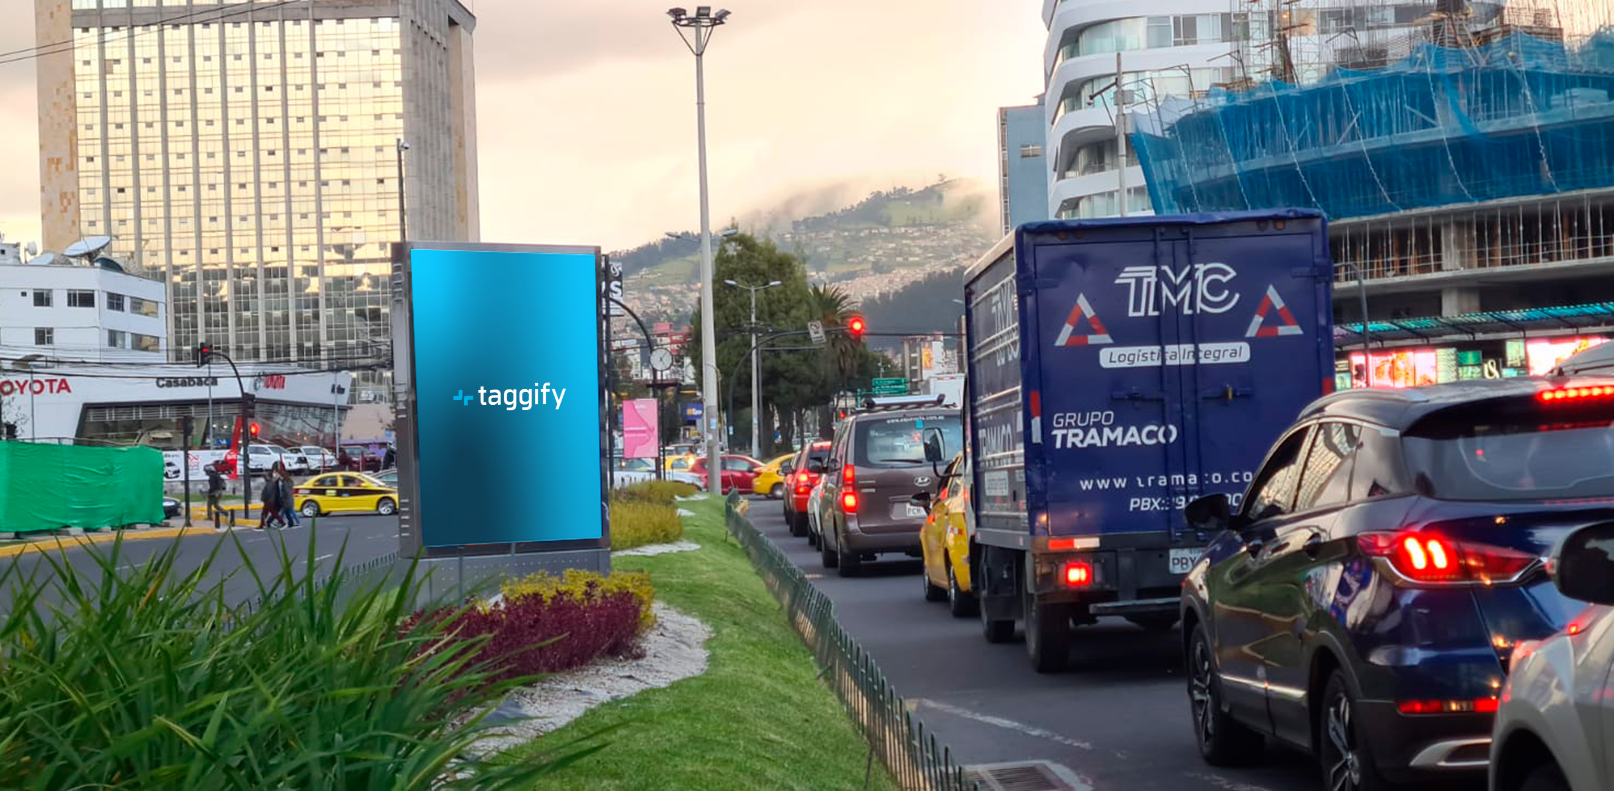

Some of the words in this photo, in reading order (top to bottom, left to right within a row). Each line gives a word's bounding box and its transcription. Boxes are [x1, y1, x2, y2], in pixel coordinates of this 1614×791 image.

[1114, 262, 1240, 317] TMC
[156, 377, 219, 388] Casabaca
[477, 382, 567, 411] taggify
[1053, 411, 1114, 427] GRUPO
[1051, 424, 1178, 449] TRAMACO
